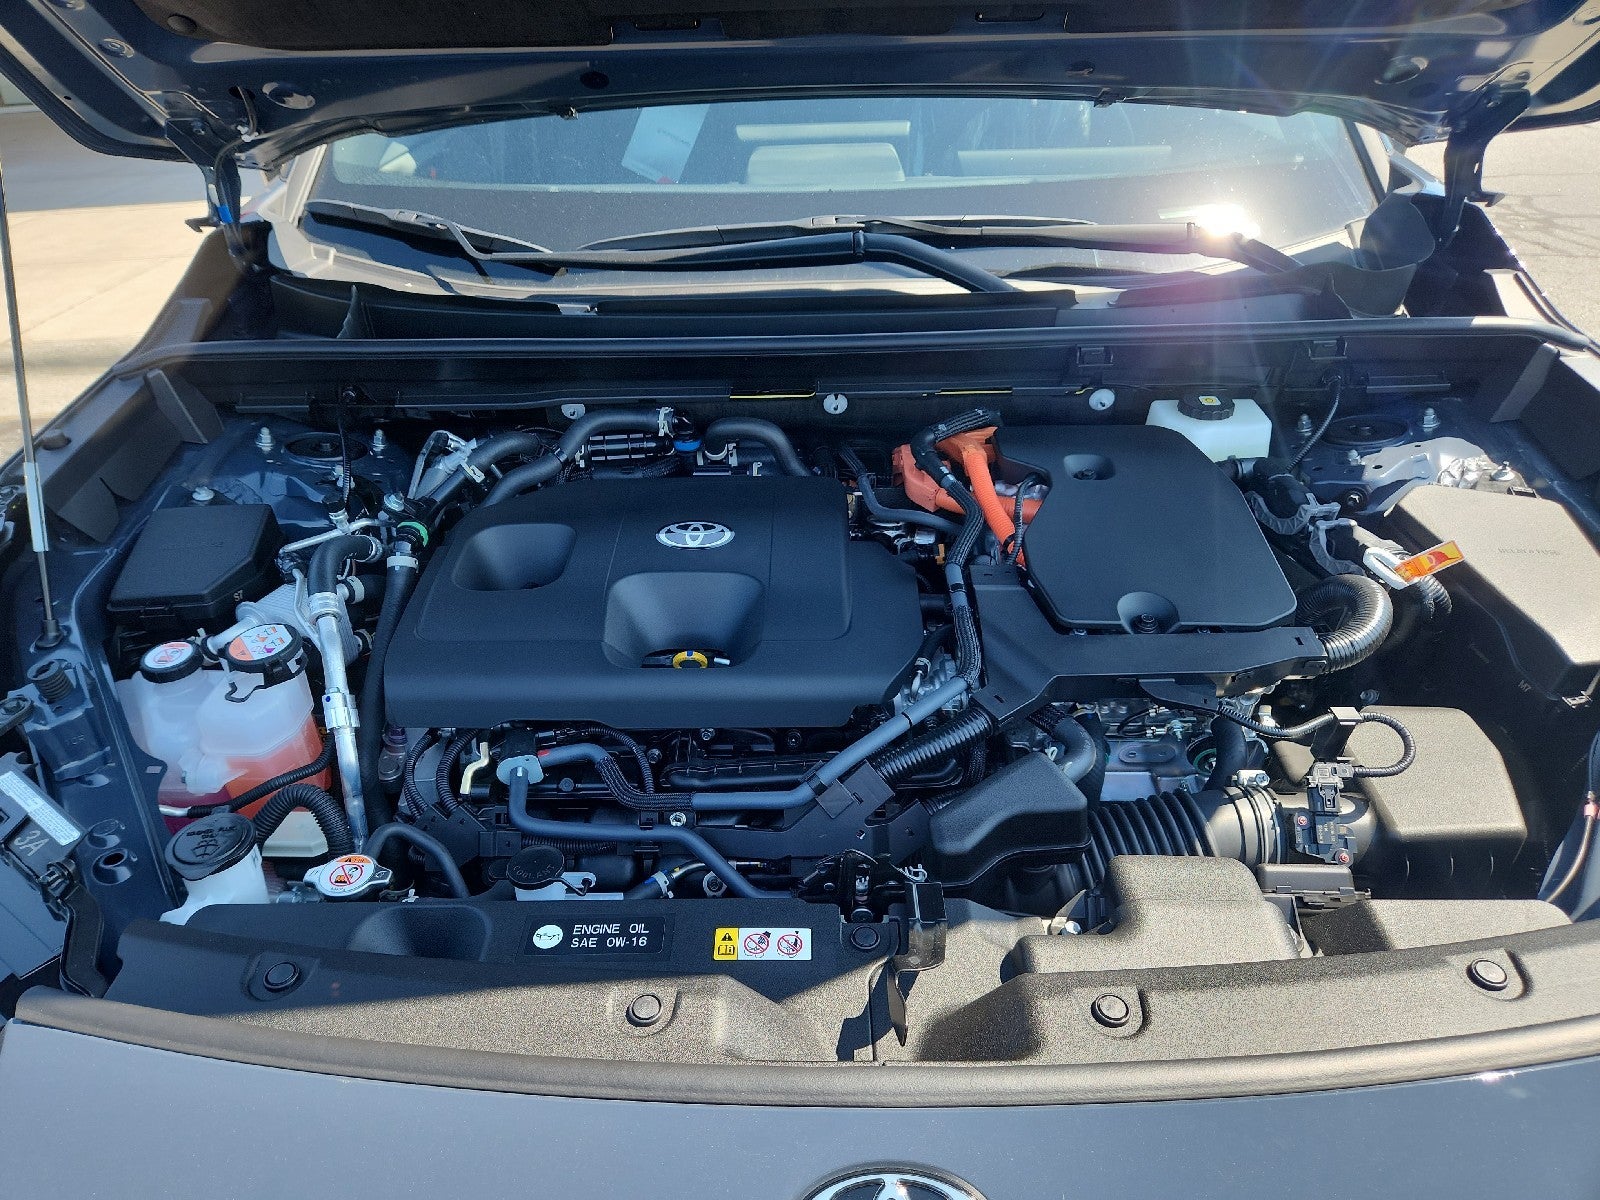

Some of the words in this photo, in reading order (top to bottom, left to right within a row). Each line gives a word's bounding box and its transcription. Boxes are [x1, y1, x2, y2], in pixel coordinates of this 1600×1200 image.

[511, 863, 556, 879] COOLANT
[572, 922, 621, 935] ENGINE
[629, 922, 650, 934] OIL
[570, 937, 598, 948] SAE
